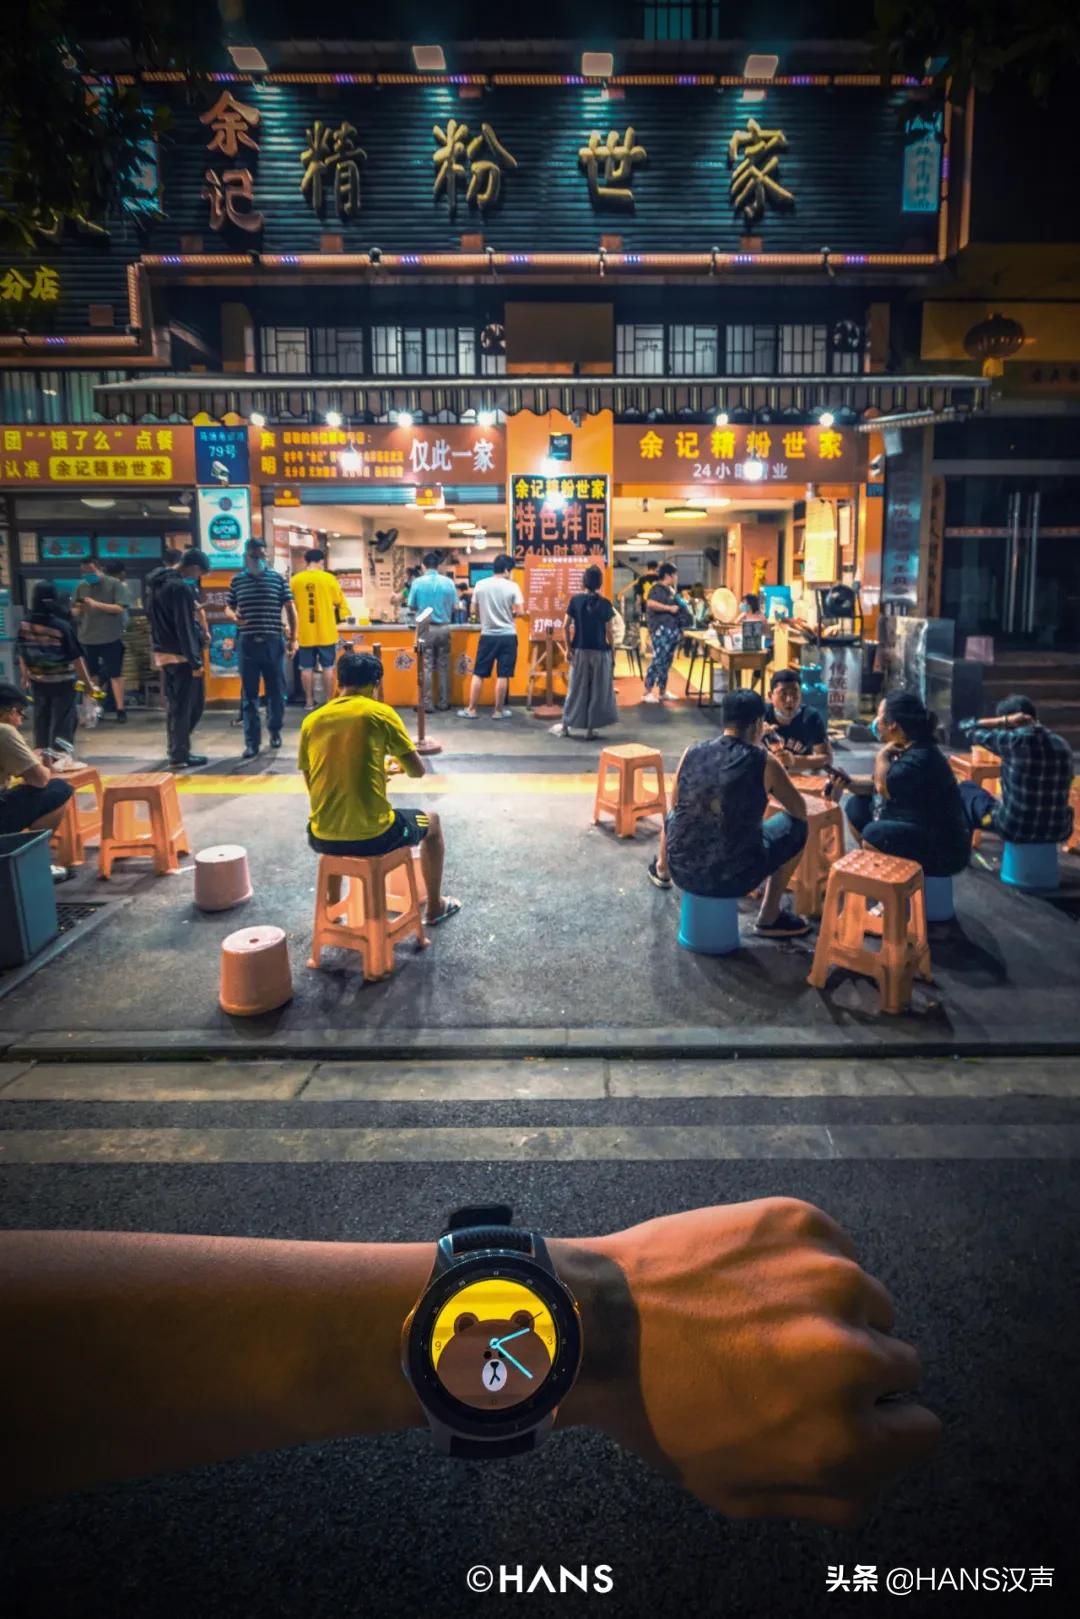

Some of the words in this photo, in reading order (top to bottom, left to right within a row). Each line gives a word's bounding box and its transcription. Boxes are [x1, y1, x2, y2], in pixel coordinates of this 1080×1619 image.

[202, 91, 264, 232] 余记
[301, 118, 796, 222] 精粉世家
[0, 264, 61, 301] 分店
[208, 444, 237, 458] 79号
[409, 438, 495, 473] 仅此一家
[639, 430, 844, 459] 余记精粉世家
[55, 461, 167, 477] 余记精粉世家
